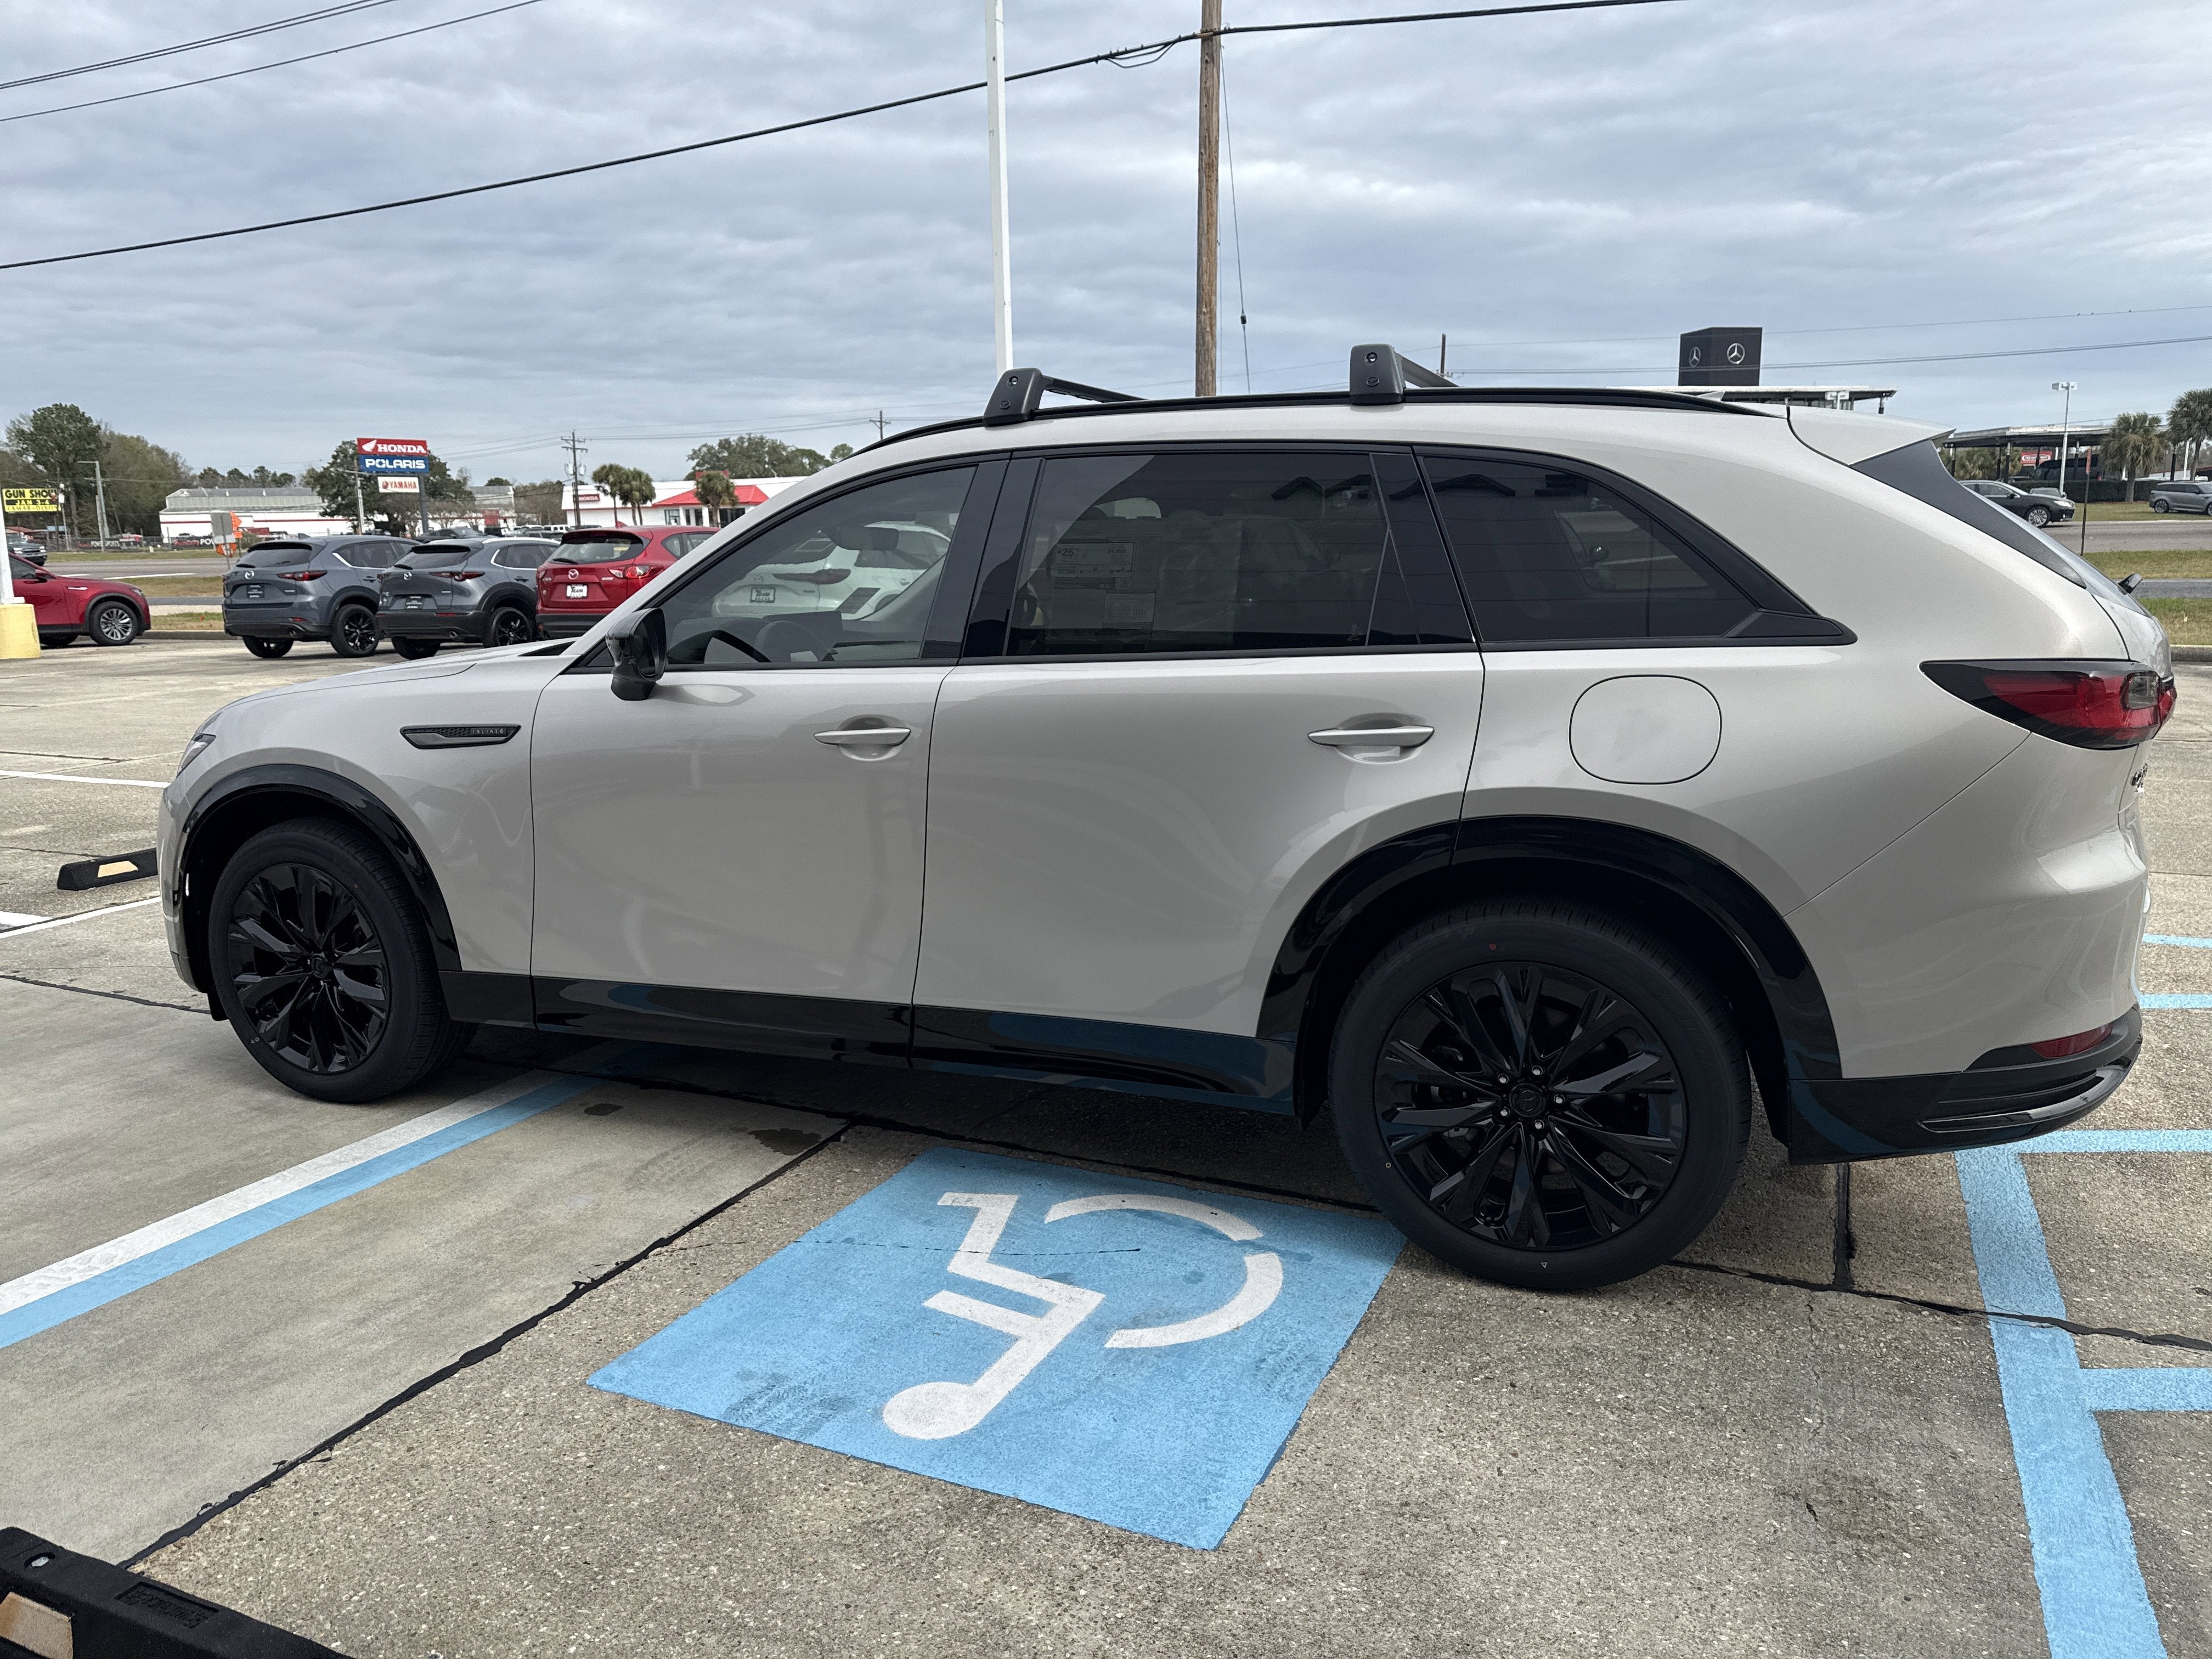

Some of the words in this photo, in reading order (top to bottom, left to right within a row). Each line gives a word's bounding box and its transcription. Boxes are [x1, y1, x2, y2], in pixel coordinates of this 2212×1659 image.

[377, 444, 427, 453] HONDA
[365, 459, 425, 469] POLARIS
[4, 489, 26, 499] GUN
[29, 489, 58, 499] SHOW
[1062, 548, 1074, 557] 25
